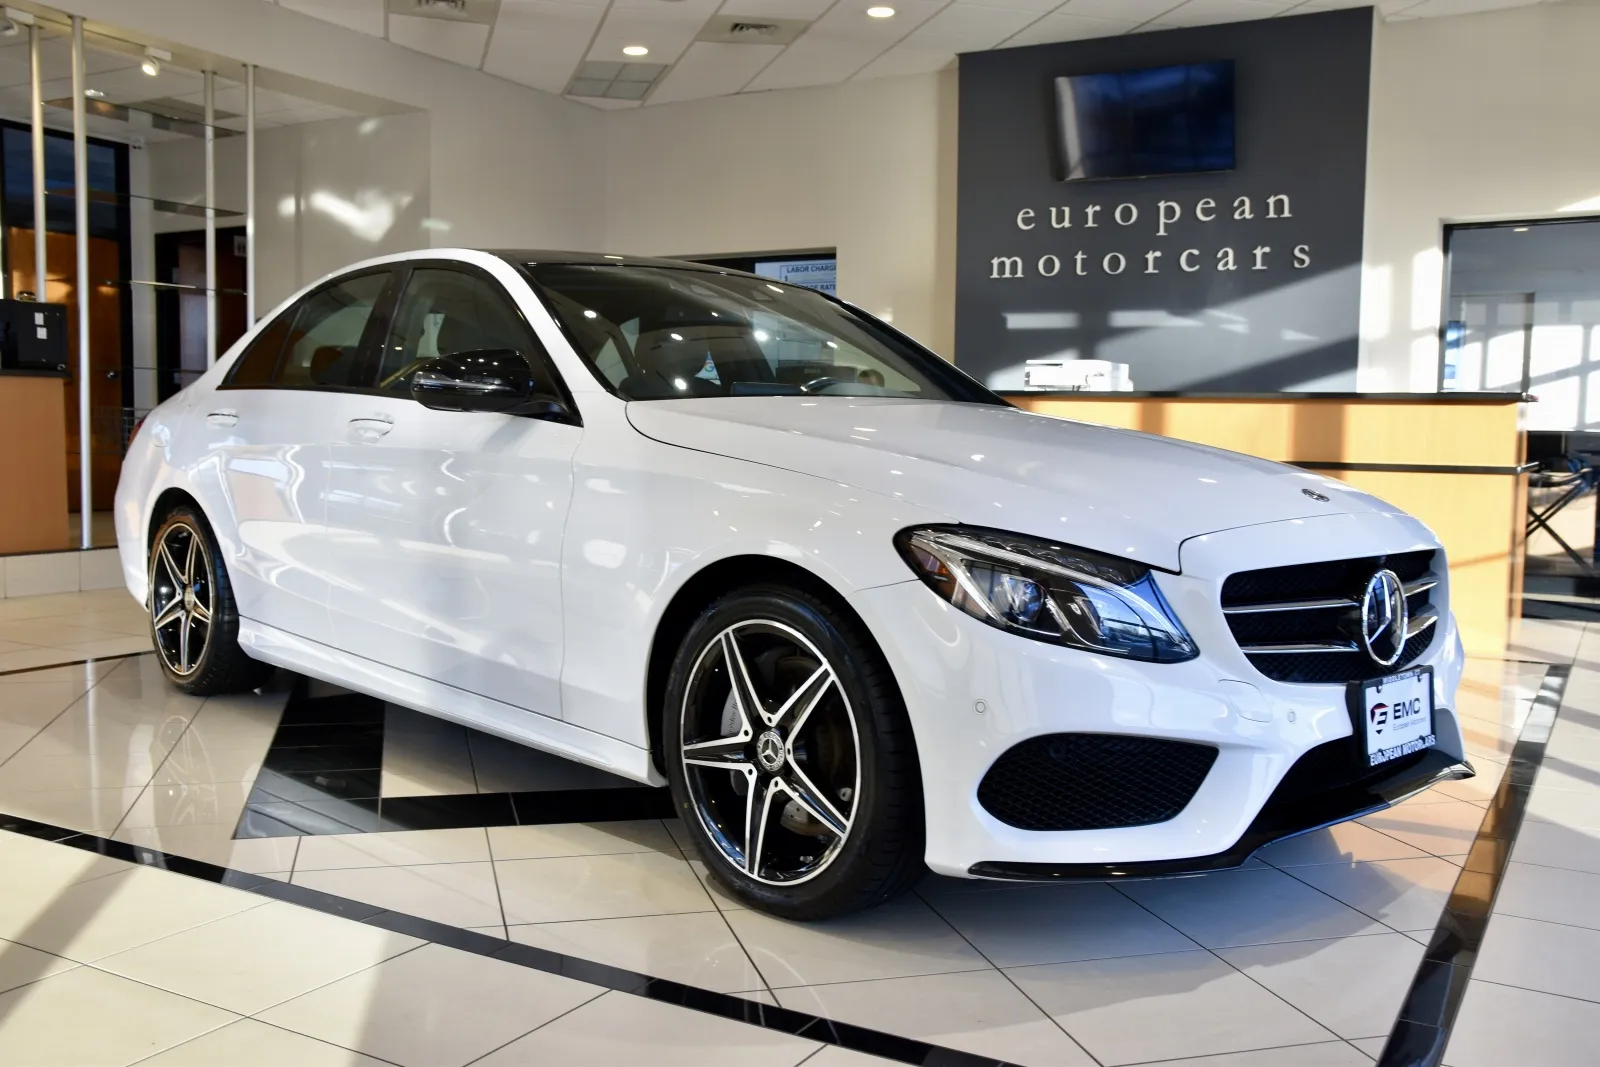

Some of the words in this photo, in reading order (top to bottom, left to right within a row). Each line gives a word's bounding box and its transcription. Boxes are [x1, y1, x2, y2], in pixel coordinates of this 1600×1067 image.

[1016, 193, 1293, 236] european
[989, 243, 1311, 279] motorcars
[1393, 697, 1421, 720] EMC
